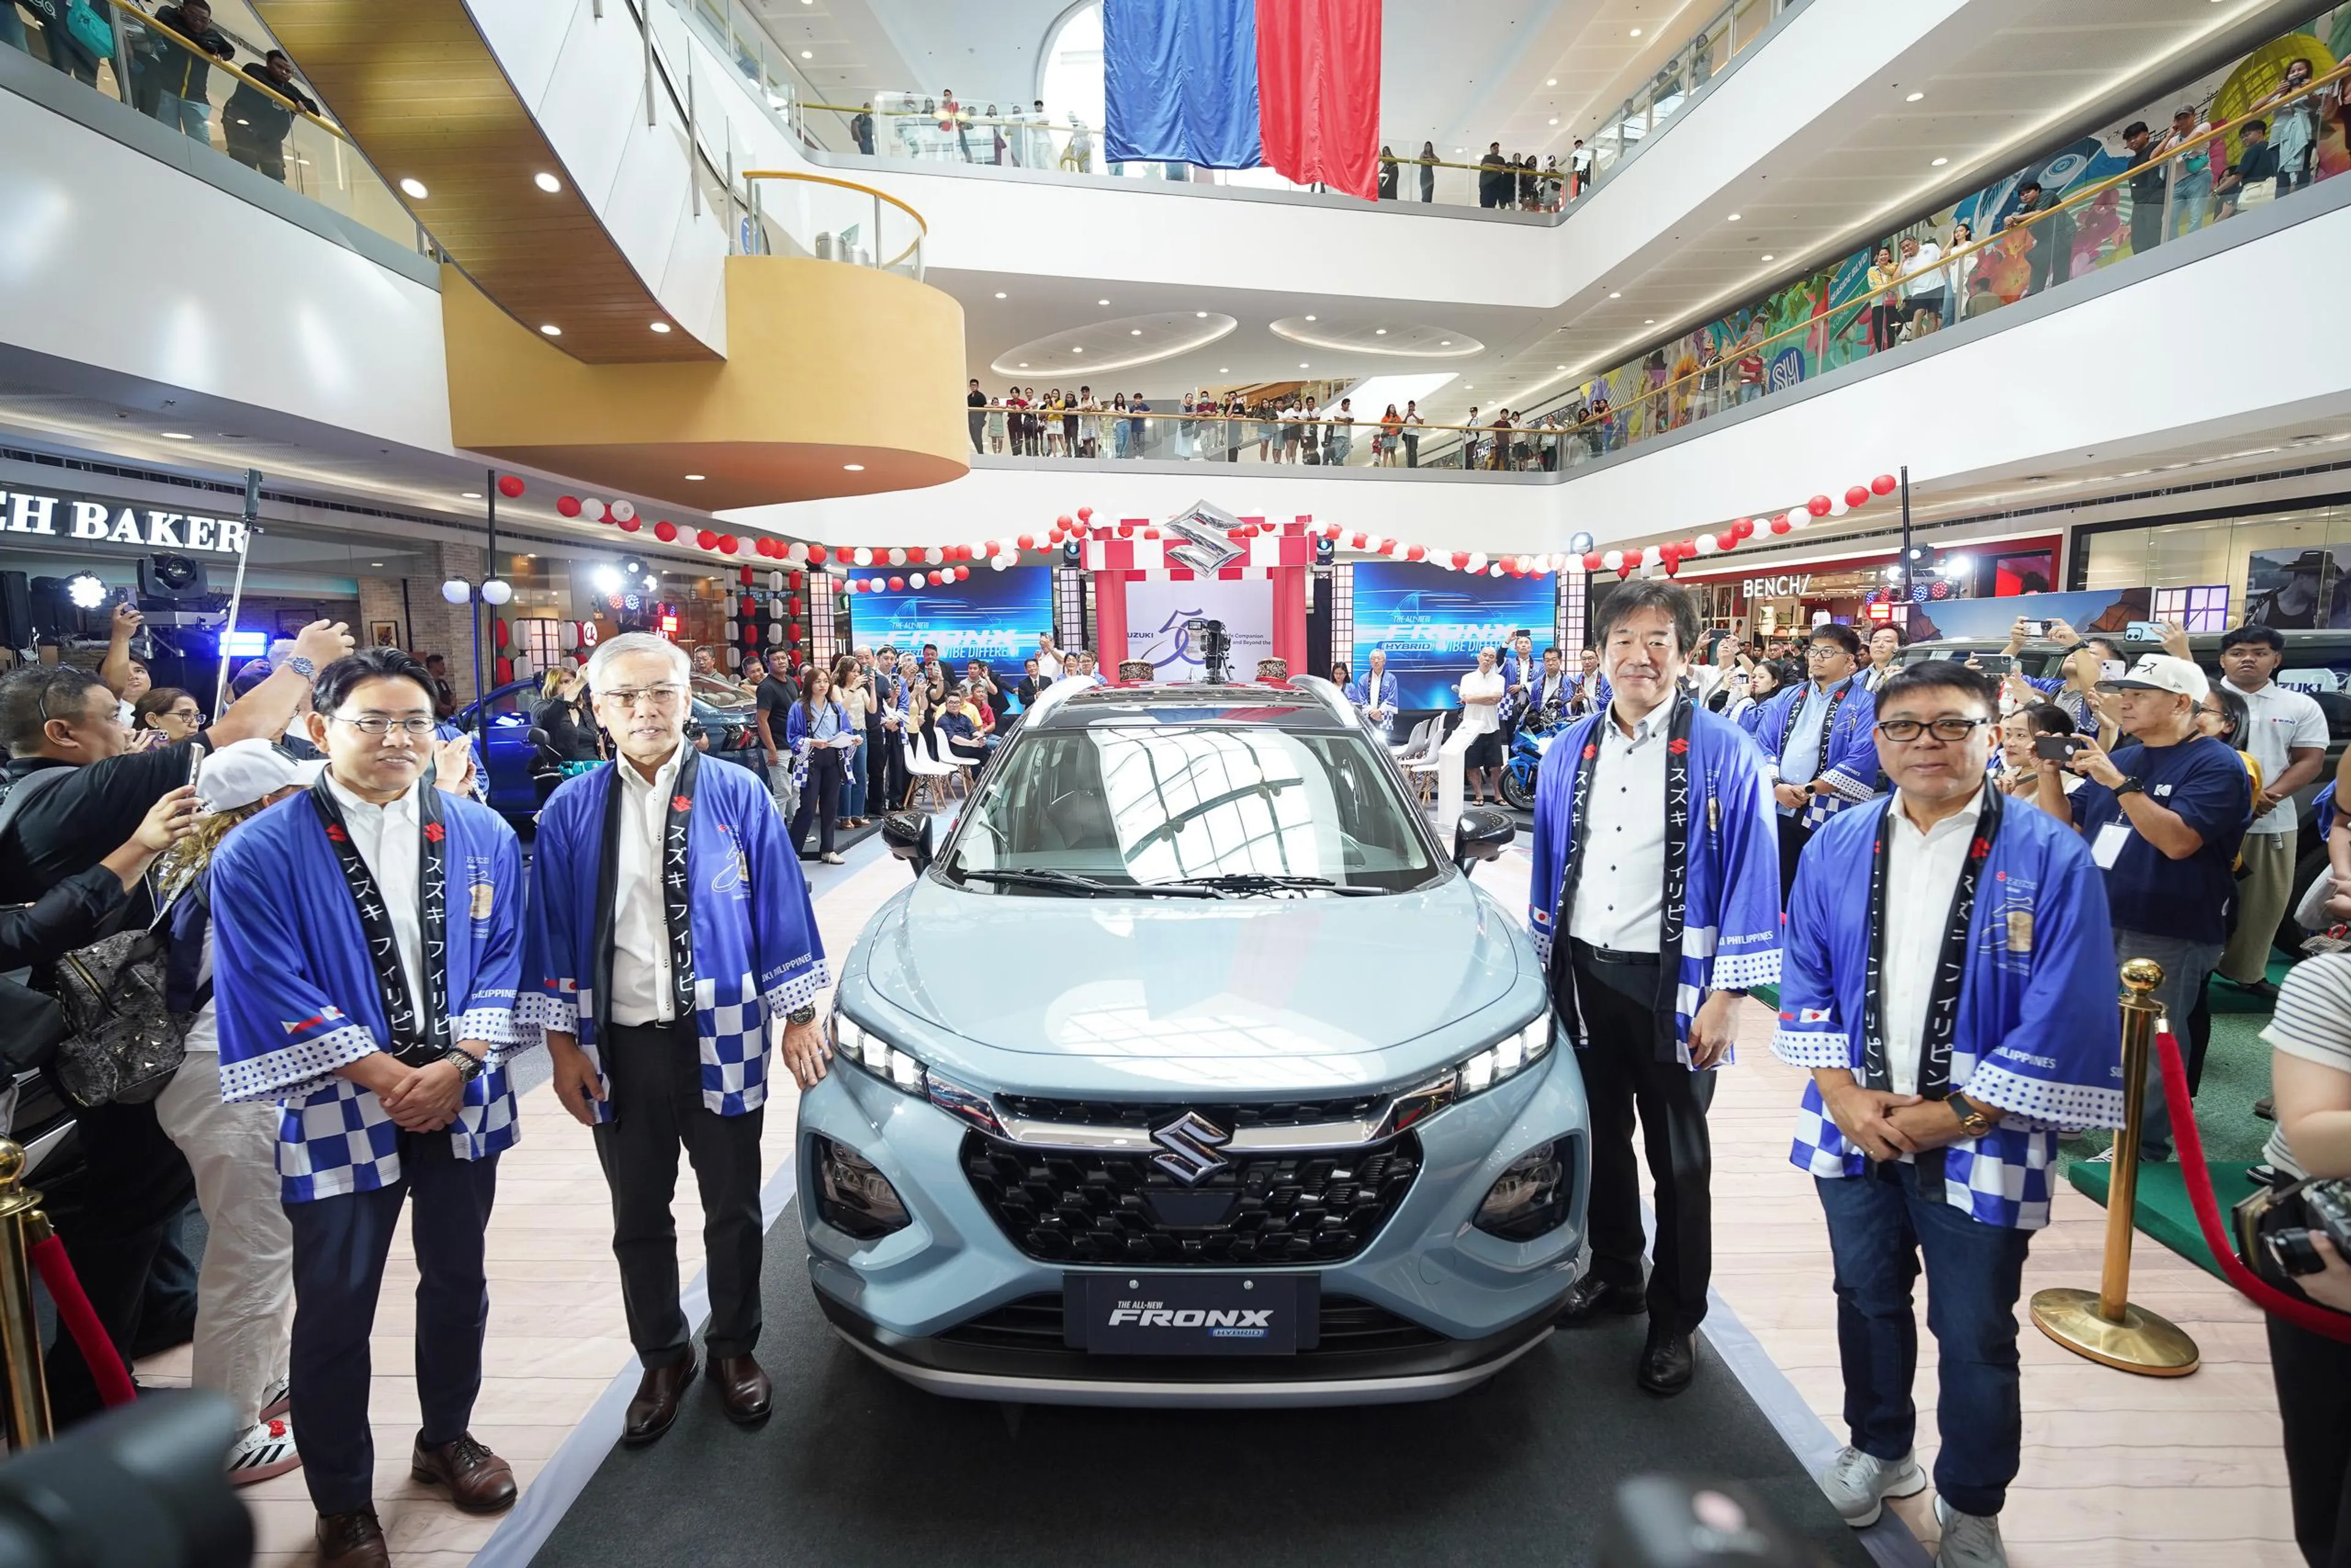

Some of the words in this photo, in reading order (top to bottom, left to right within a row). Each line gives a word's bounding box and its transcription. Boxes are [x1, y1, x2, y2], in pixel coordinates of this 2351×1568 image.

[1831, 272, 1851, 304] SEASIDE
[1851, 253, 1867, 278] BLVD
[1727, 930, 1774, 945] PHILIPPINES
[1117, 1300, 1131, 1309] THE
[1132, 1300, 1163, 1309] ALL-NEW
[1108, 1309, 1274, 1327] FRONX
